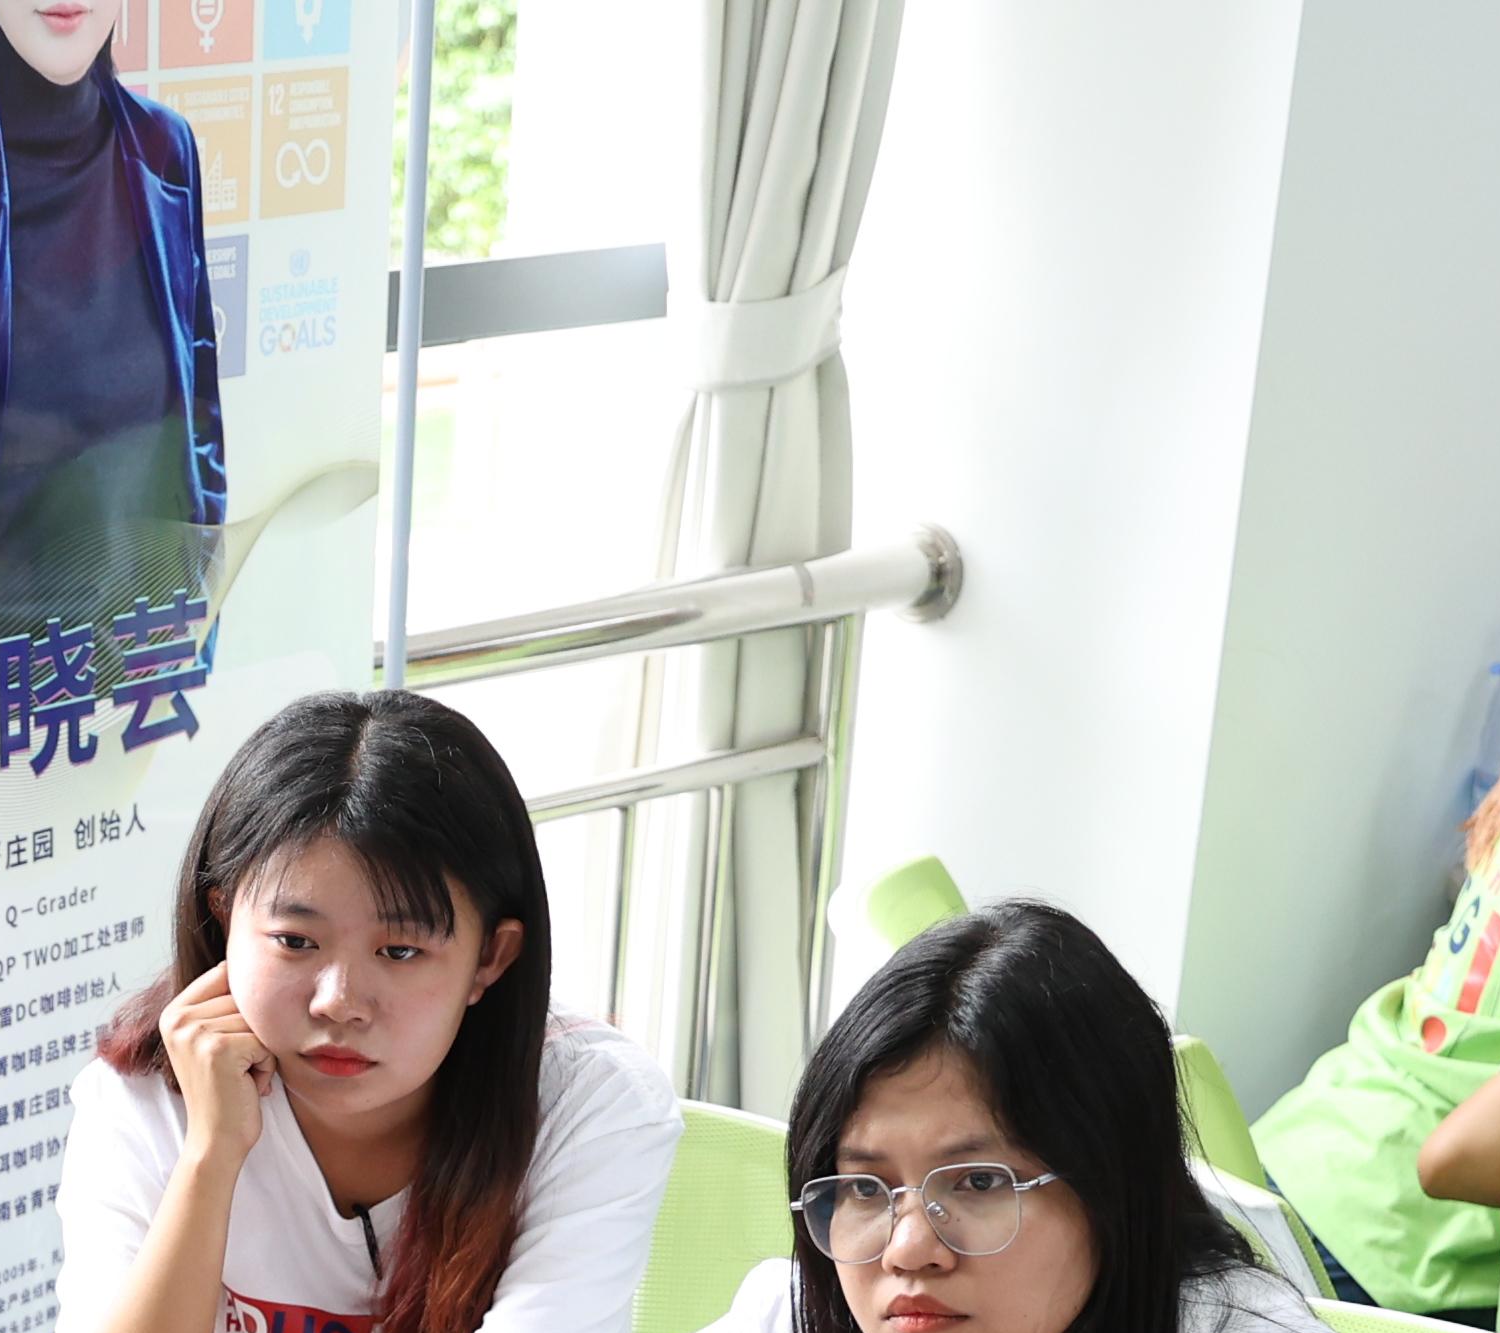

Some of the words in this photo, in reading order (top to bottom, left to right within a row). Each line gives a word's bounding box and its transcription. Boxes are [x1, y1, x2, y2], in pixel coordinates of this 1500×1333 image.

[269, 83, 285, 116] 12
[260, 277, 340, 303] SUSTAINABLE
[258, 316, 338, 357] GOALS
[74, 803, 146, 850] 创始人
